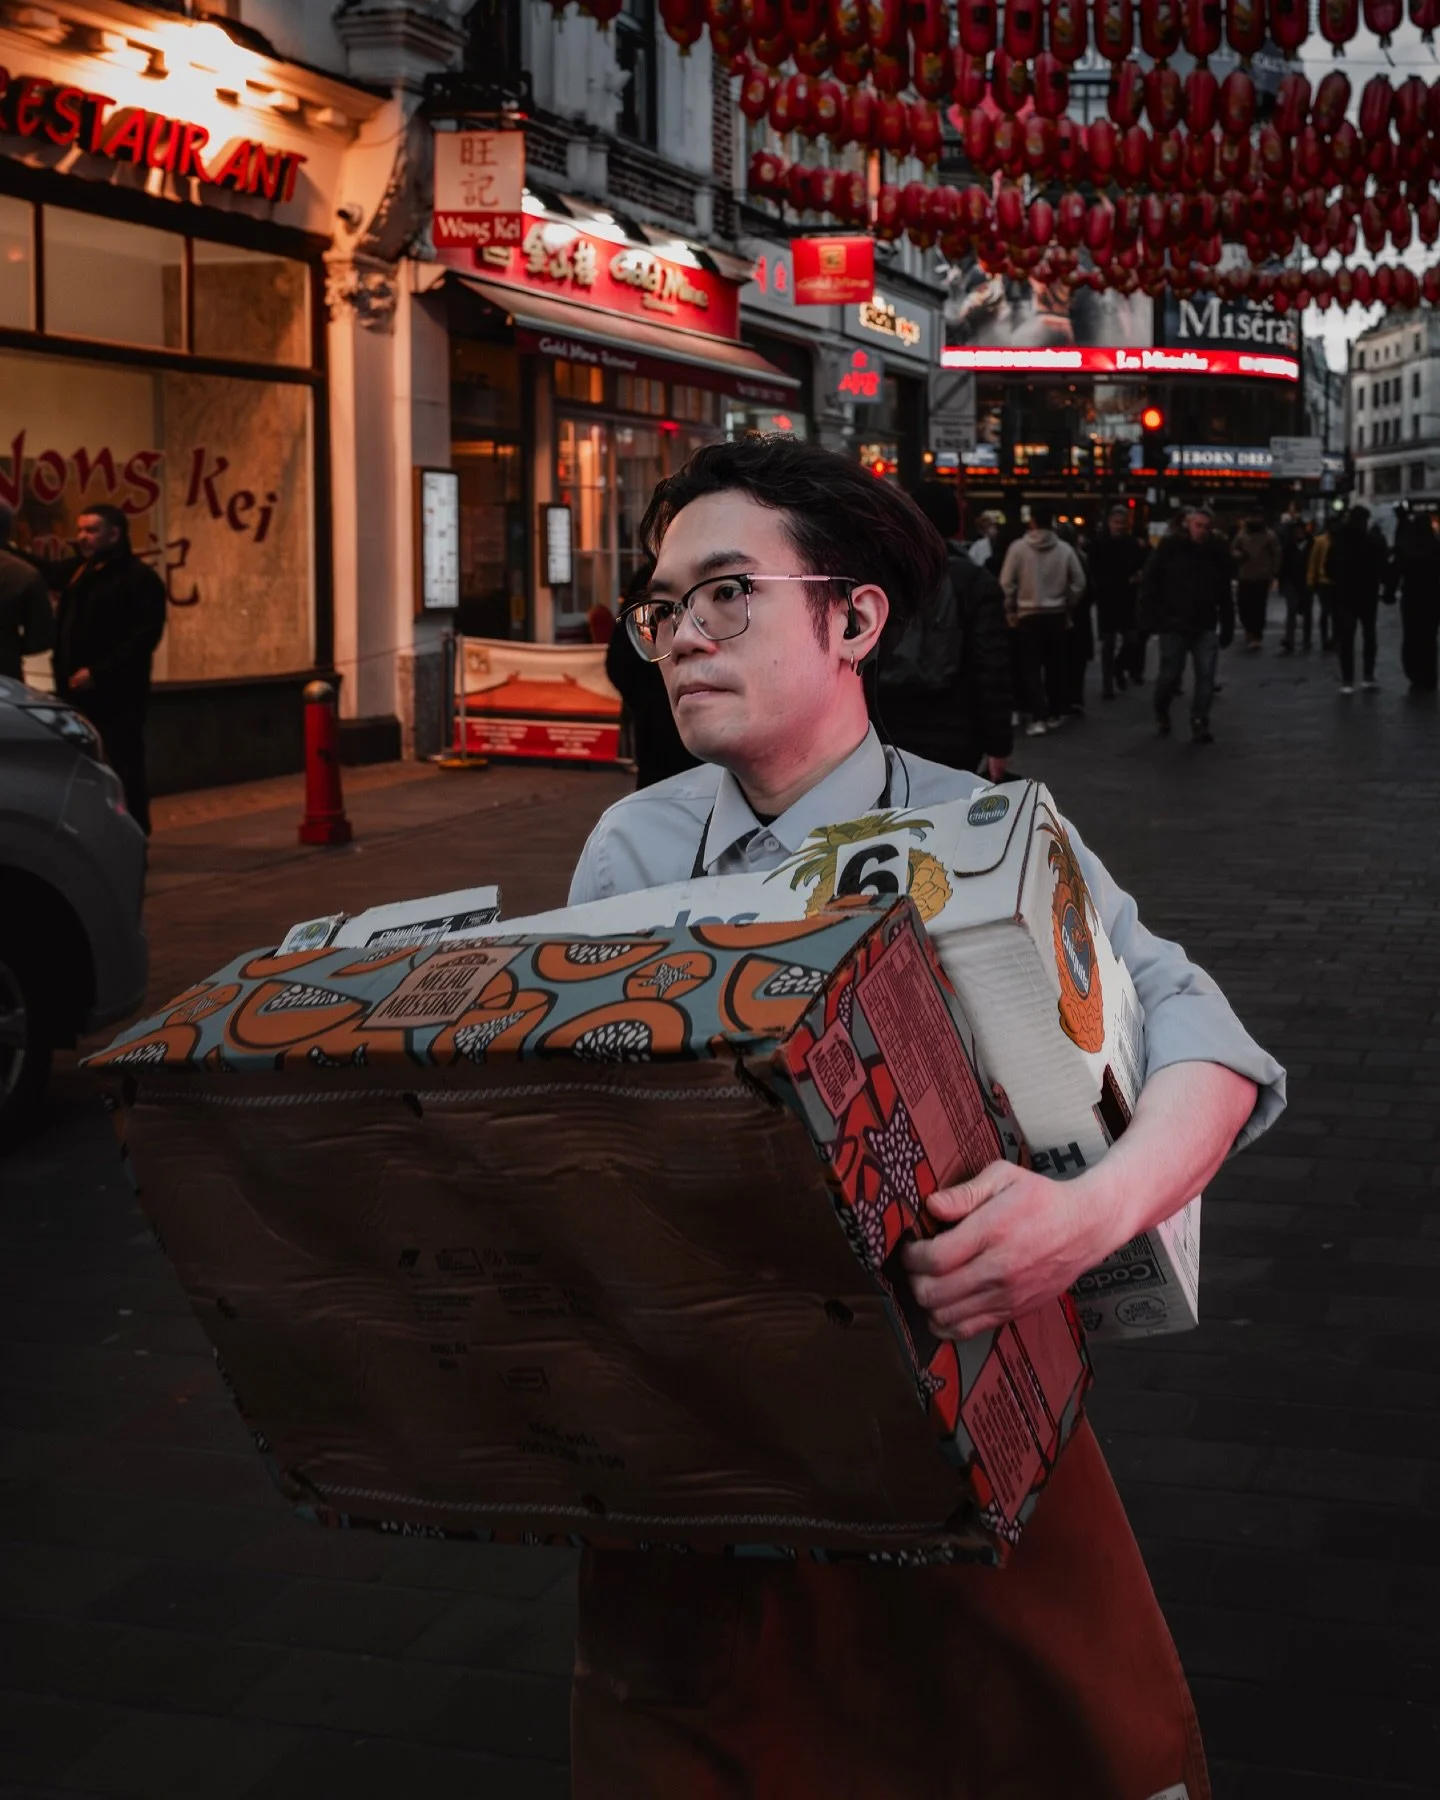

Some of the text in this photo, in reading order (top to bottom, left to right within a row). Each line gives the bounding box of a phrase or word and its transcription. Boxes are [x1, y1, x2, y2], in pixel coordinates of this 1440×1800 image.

[460, 137, 500, 207] 旺記
[437, 215, 521, 244] Wong Kei
[186, 447, 278, 543] Kei
[969, 808, 1006, 821] Chiquita
[837, 843, 900, 896] 6
